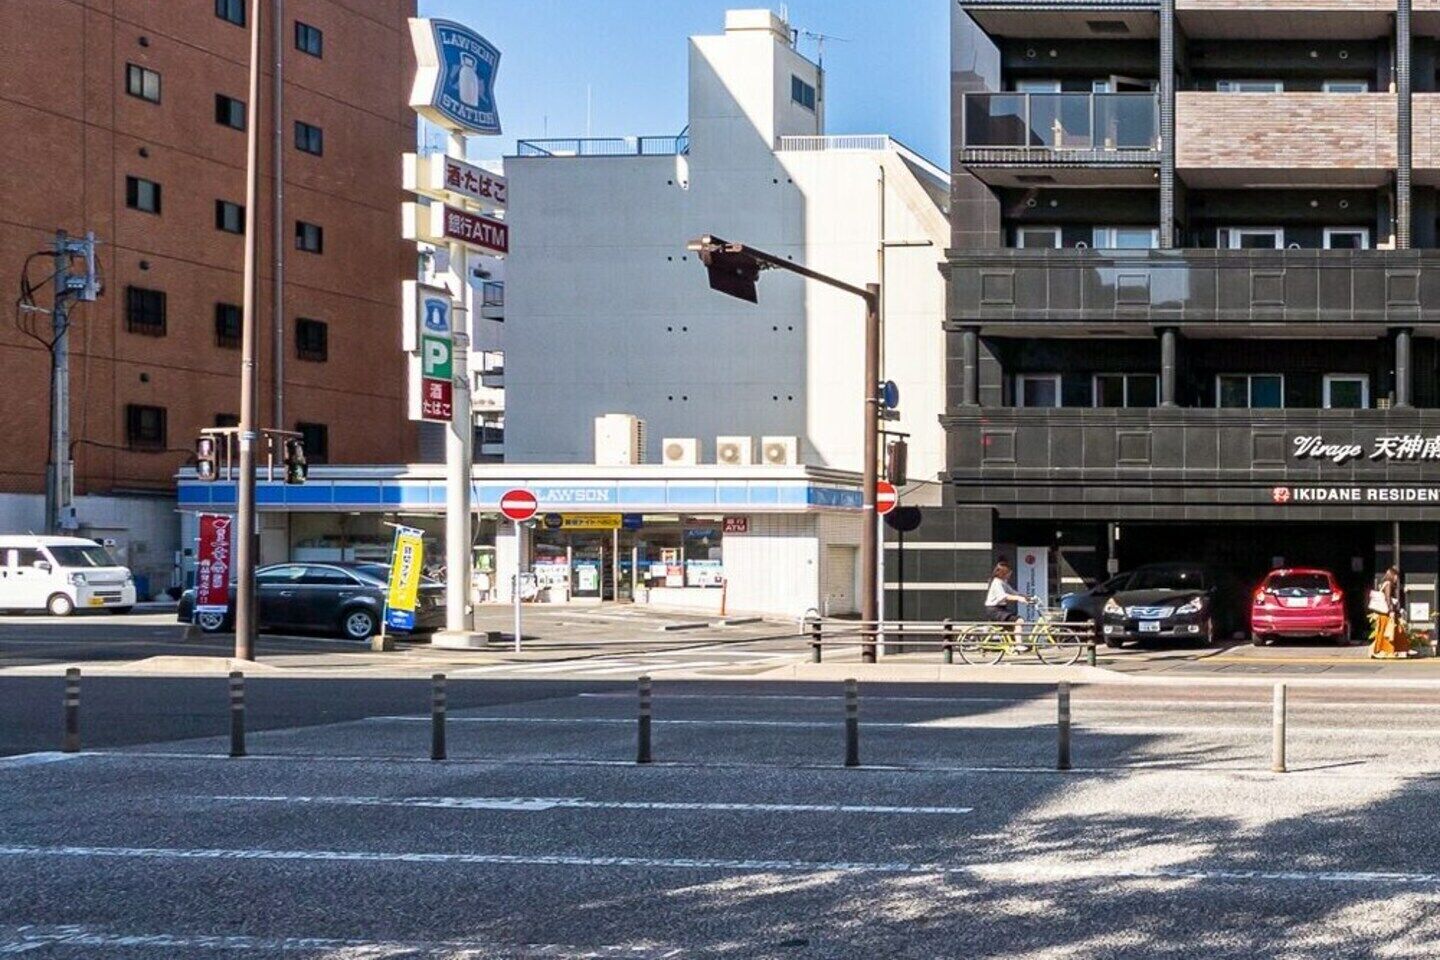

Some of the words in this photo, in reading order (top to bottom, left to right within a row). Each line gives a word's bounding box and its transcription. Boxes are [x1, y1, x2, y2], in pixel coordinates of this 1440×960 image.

[441, 31, 496, 65] LAWSON
[442, 94, 495, 124] STATION
[447, 213, 506, 248] 銀行ATM
[424, 339, 449, 373] P
[430, 383, 443, 399] 酒
[423, 400, 451, 417] たばこ
[1293, 435, 1362, 463] Virage
[536, 489, 609, 502] LAWSON
[1293, 488, 1362, 501] IKIDANE
[725, 524, 746, 532] ATM
